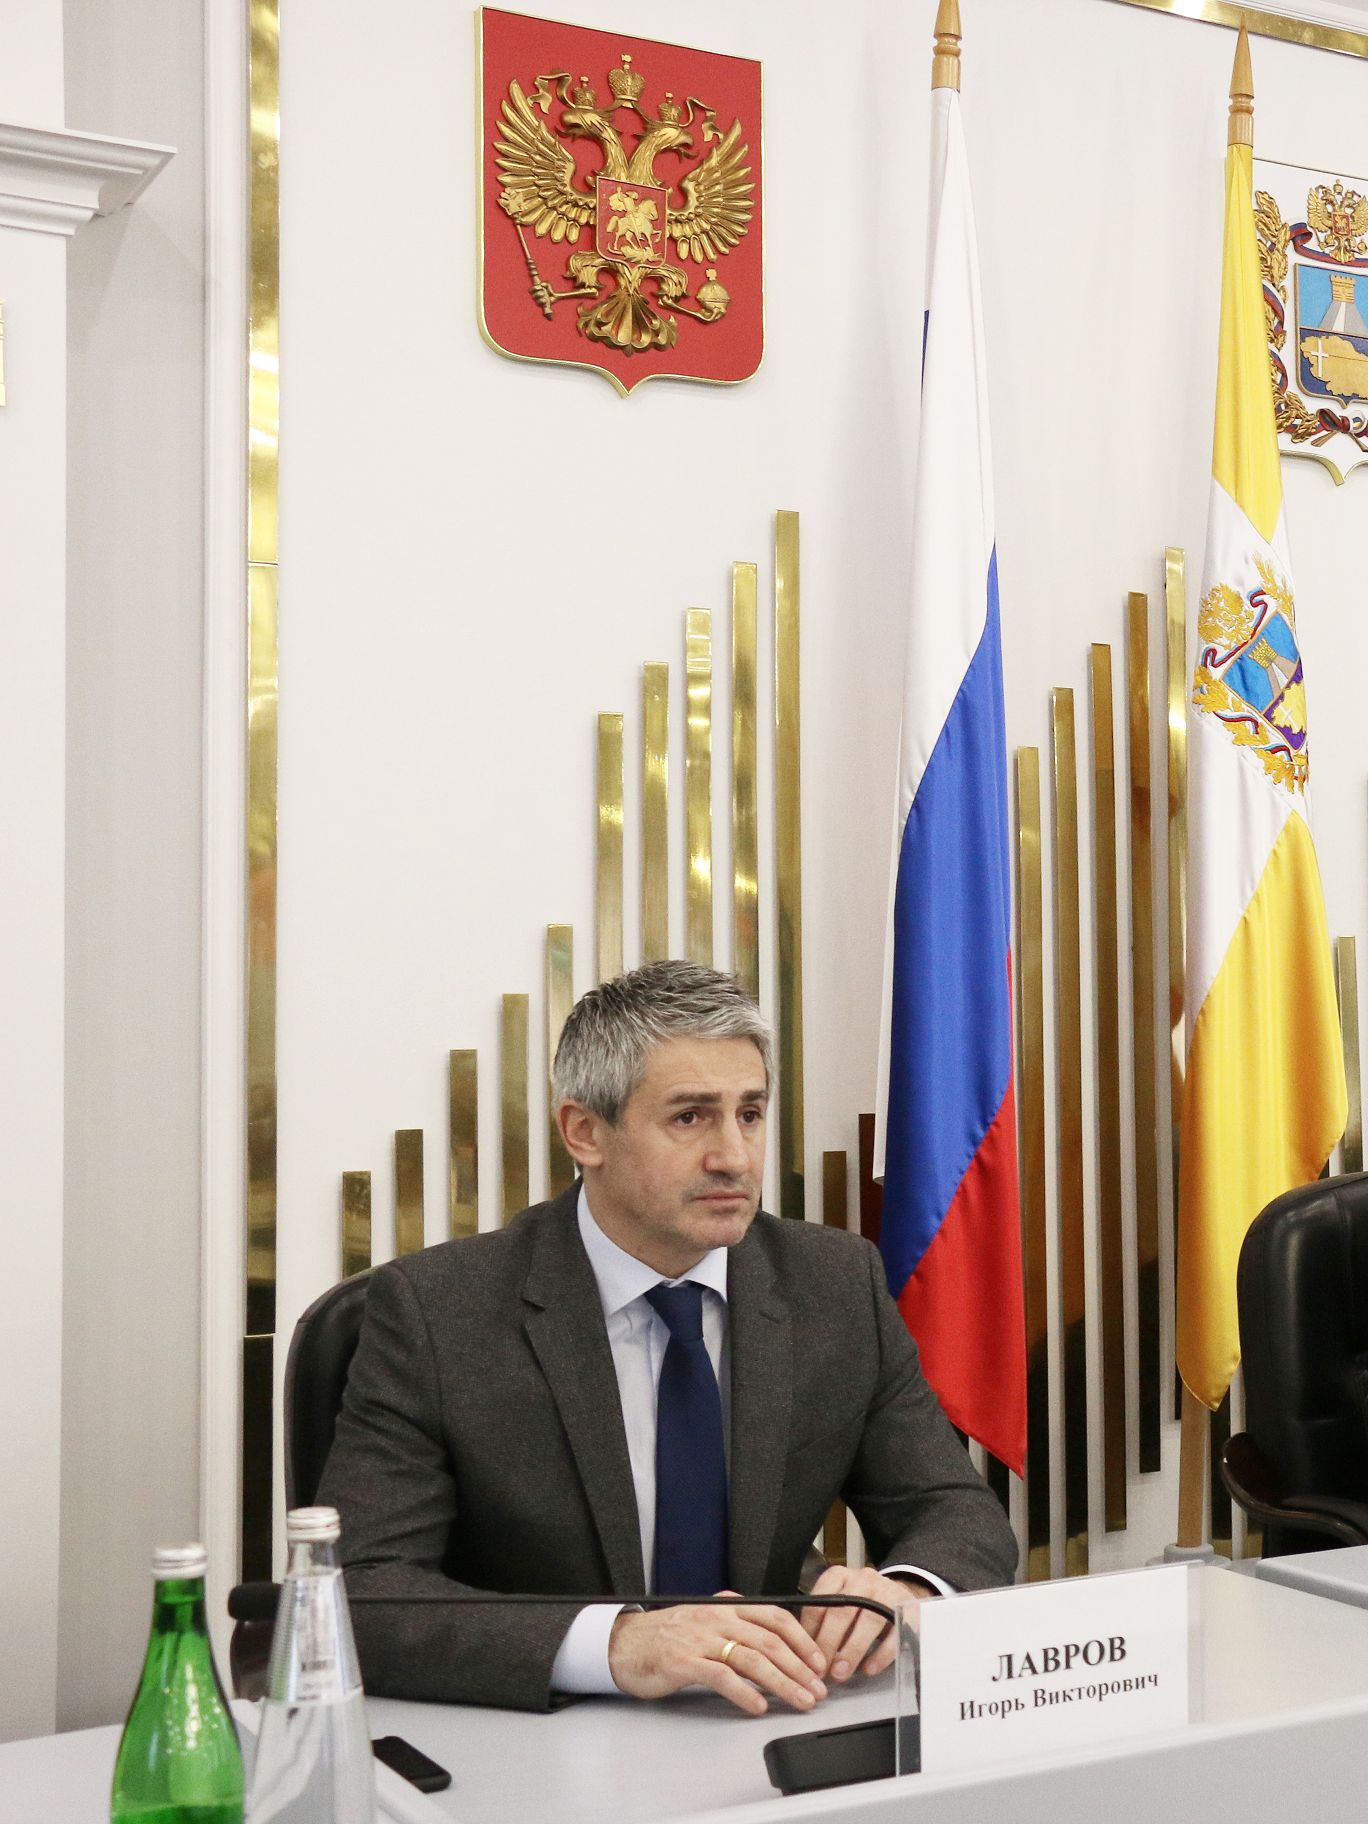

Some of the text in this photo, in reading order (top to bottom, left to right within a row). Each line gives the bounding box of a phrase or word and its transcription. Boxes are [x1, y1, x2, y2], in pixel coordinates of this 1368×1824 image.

[991, 1636, 1127, 1682] ЛАВРОВ
[959, 1673, 1159, 1721] Игорь Викторович
